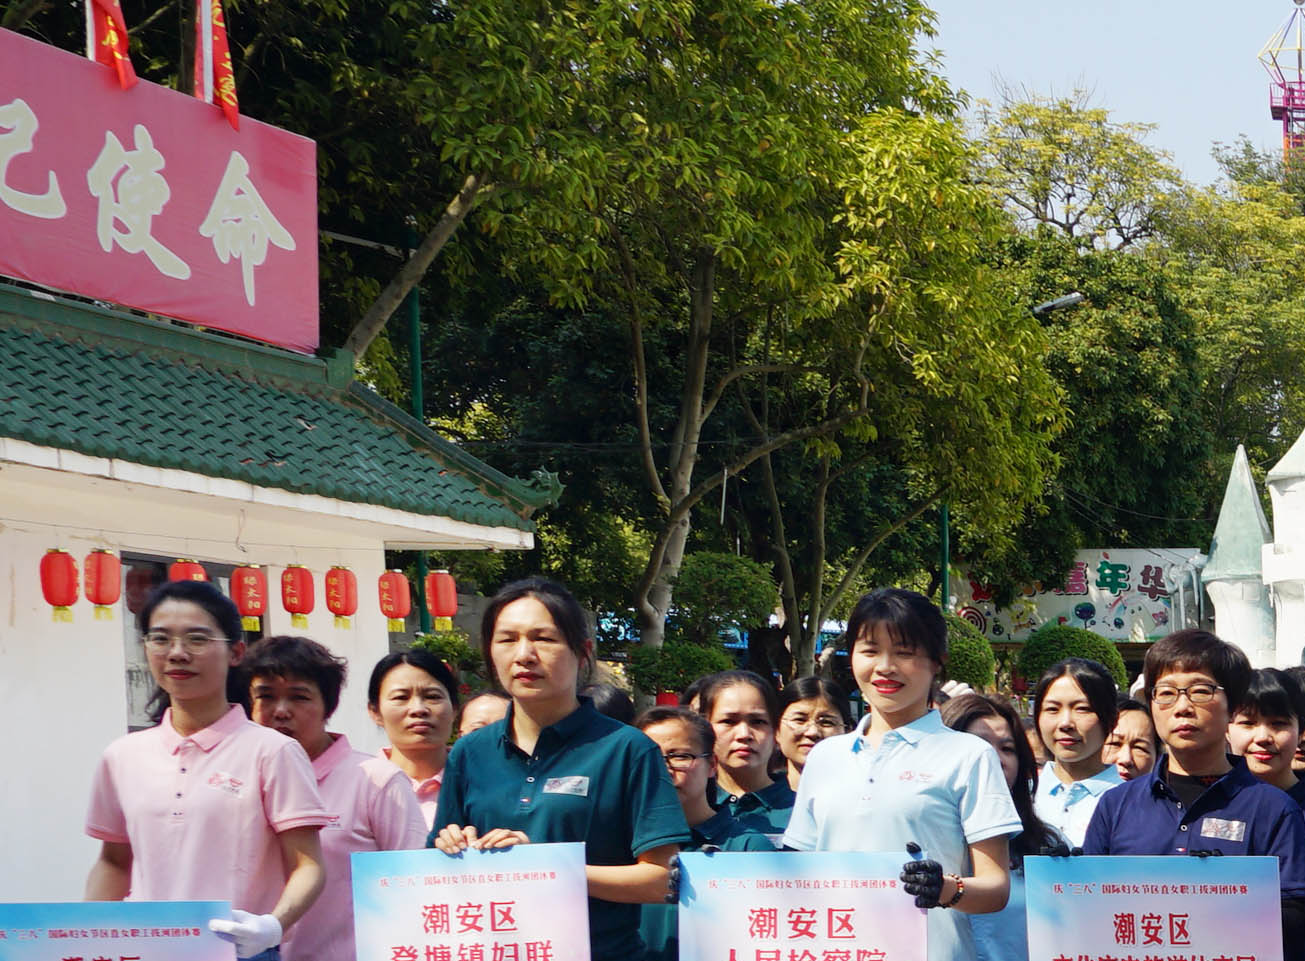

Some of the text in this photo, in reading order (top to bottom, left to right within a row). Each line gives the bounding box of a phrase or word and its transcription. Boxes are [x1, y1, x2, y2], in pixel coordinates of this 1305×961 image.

[421, 901, 518, 934] 潮安区
[748, 907, 856, 939] 潮安区
[1113, 912, 1191, 946] 潮安区
